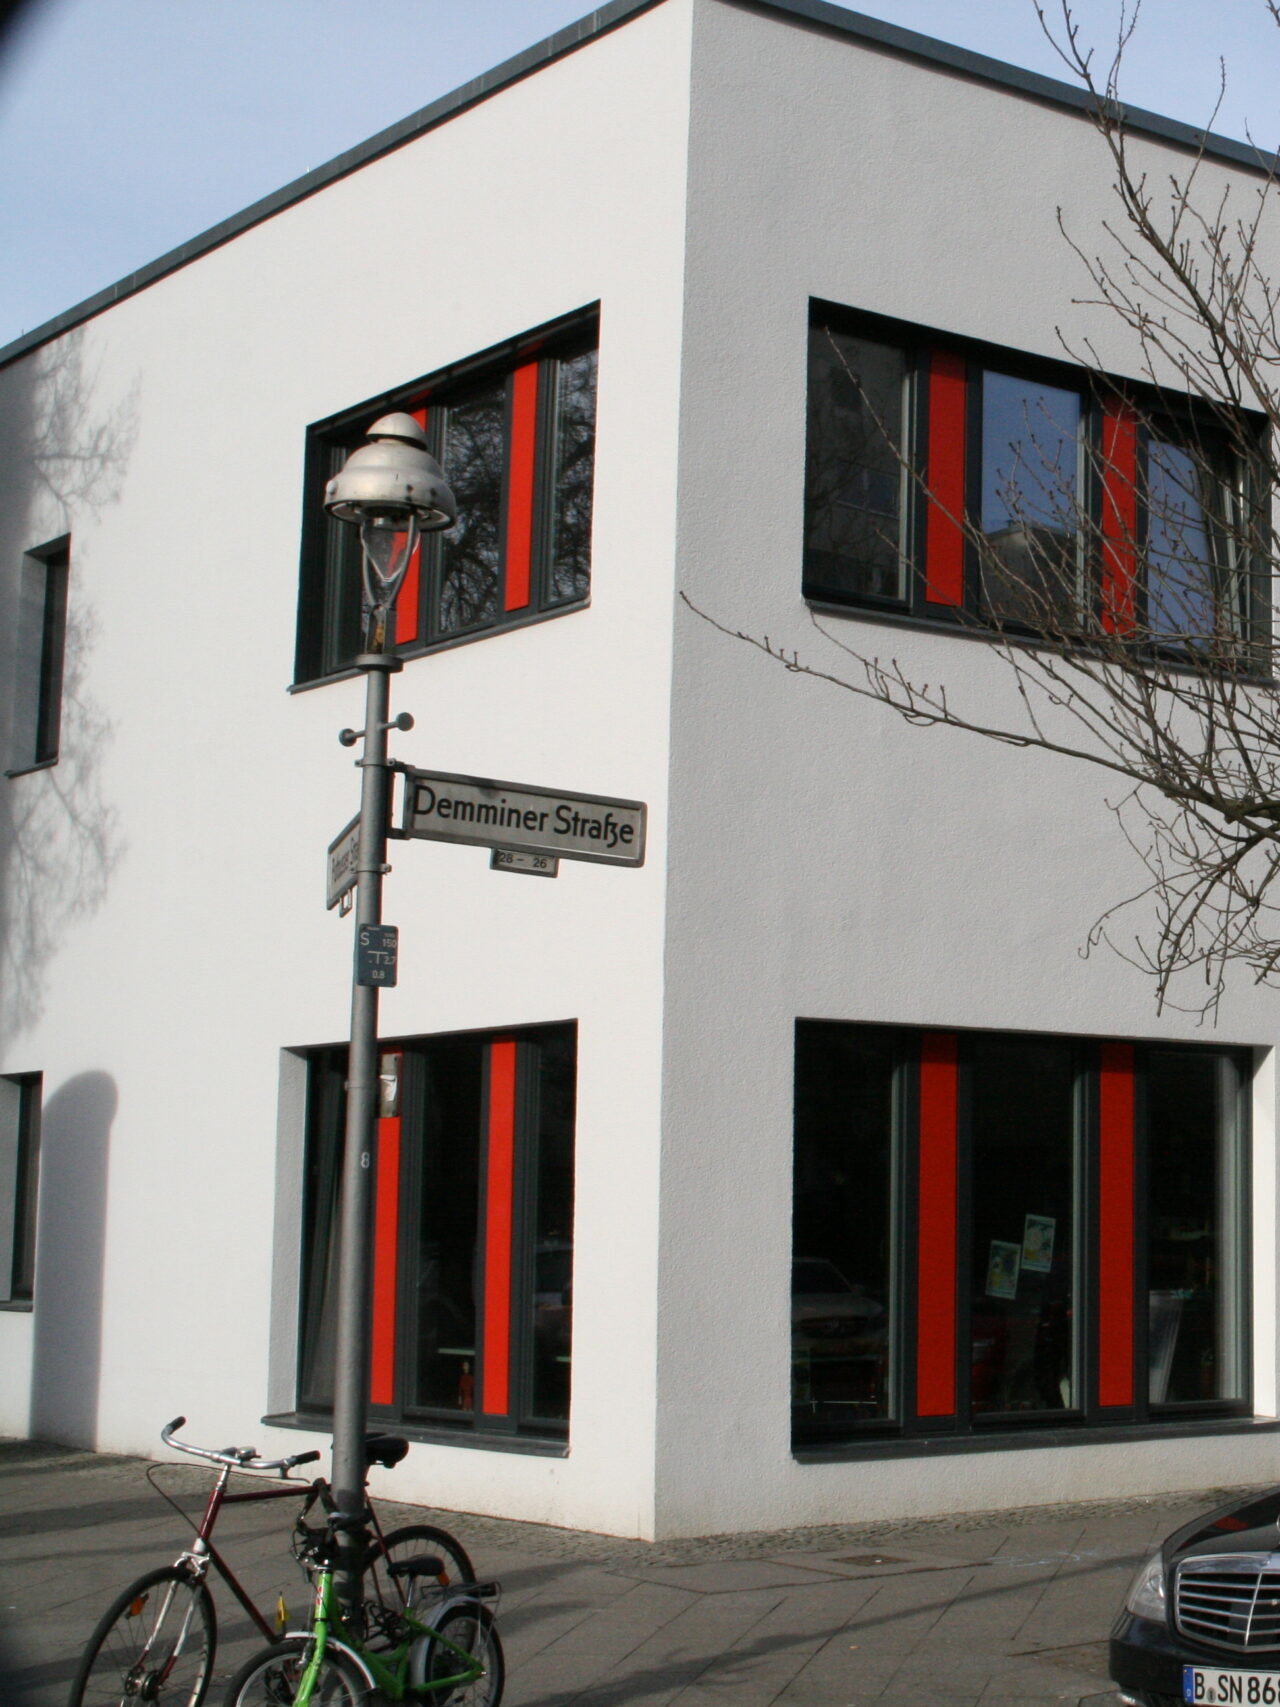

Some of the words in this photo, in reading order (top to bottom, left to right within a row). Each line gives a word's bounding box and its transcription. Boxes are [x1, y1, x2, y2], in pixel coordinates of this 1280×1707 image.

[414, 784, 549, 832] Demminer
[553, 804, 635, 849] Straße
[499, 852, 514, 864] 28
[533, 857, 547, 869] 26
[360, 931, 370, 946] S
[360, 1151, 370, 1169] 8
[1194, 1671, 1206, 1700] B
[1217, 1674, 1243, 1703] SN
